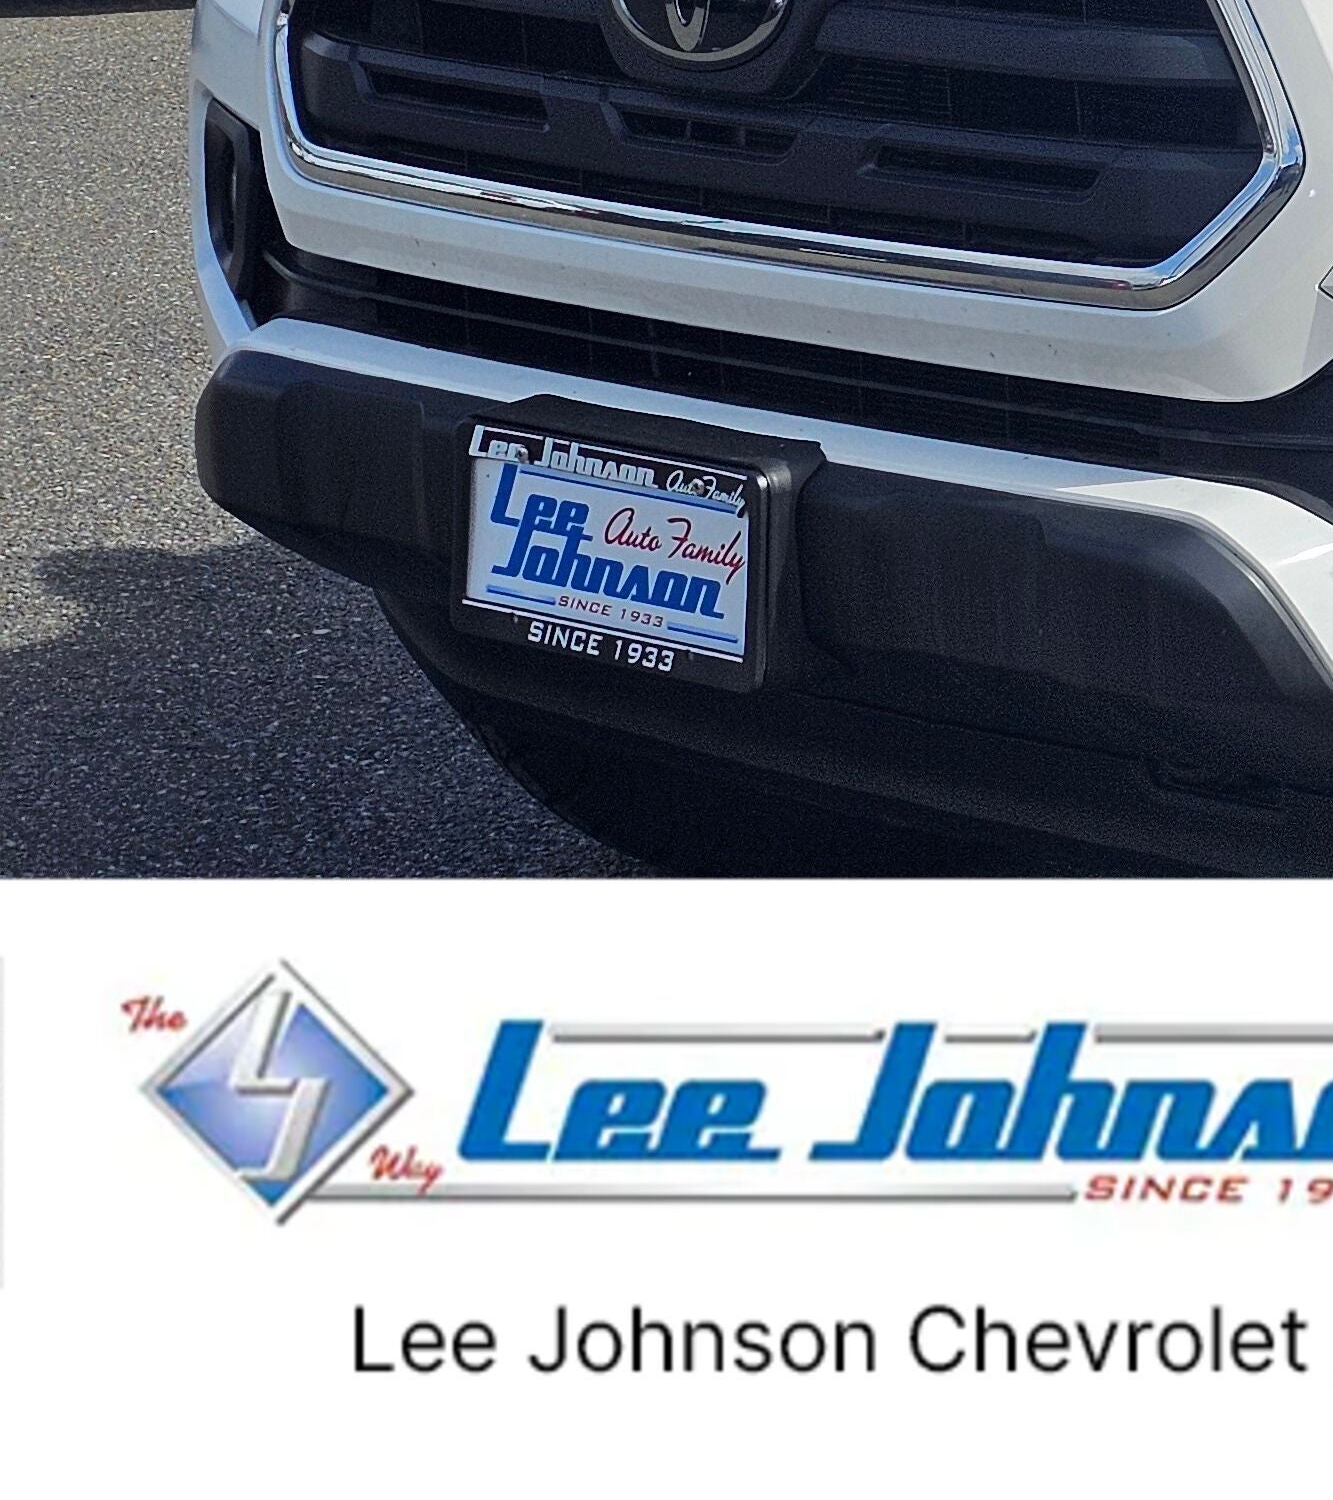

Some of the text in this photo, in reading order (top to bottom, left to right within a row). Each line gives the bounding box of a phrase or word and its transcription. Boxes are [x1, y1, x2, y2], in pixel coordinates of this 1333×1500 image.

[490, 463, 593, 541] Lee
[533, 436, 659, 489] Johnson
[666, 469, 704, 496] Aut
[702, 475, 746, 517] Family
[490, 522, 725, 620] Johnson
[604, 507, 746, 585] Auto Family
[527, 621, 675, 672] SINCE 1933
[558, 595, 664, 628] SINCE 1933
